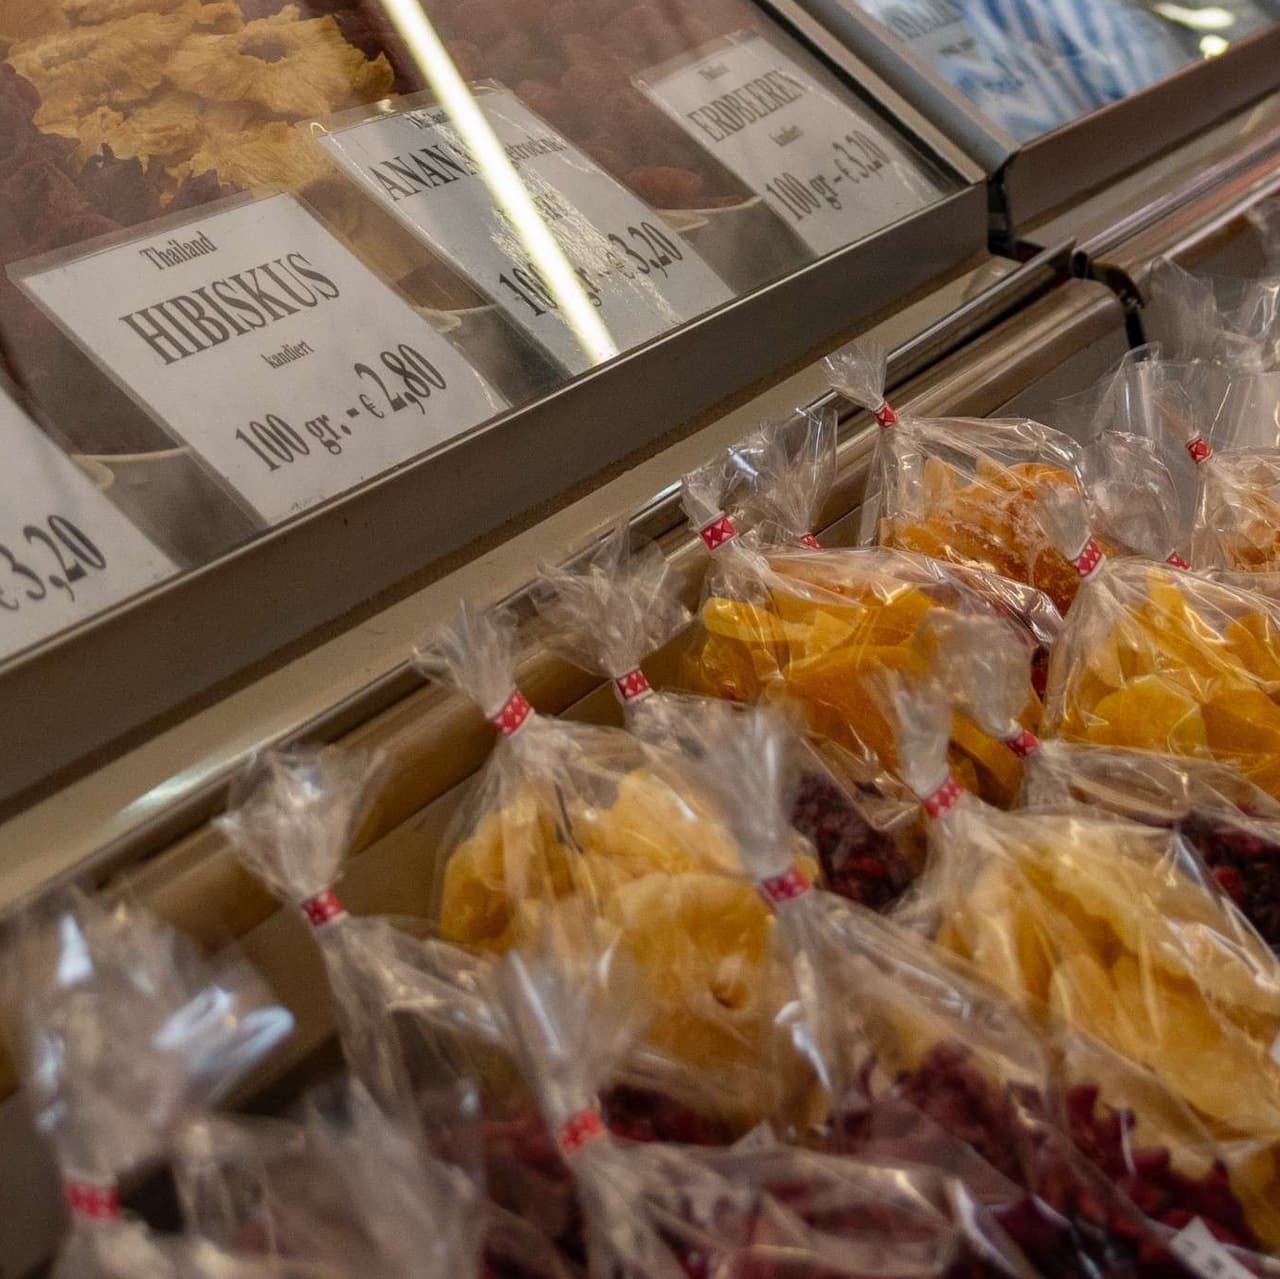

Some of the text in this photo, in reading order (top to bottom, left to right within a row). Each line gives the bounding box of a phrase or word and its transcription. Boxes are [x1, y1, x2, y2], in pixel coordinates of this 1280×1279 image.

[686, 68, 810, 143] ERDBEEREN
[766, 172, 822, 221] 100
[138, 230, 218, 271] Thailand
[609, 221, 684, 280] 3,20
[119, 251, 341, 366] HIBISKUS
[260, 339, 316, 370] kandiert
[235, 412, 311, 472] 100
[354, 342, 448, 415] 2,80
